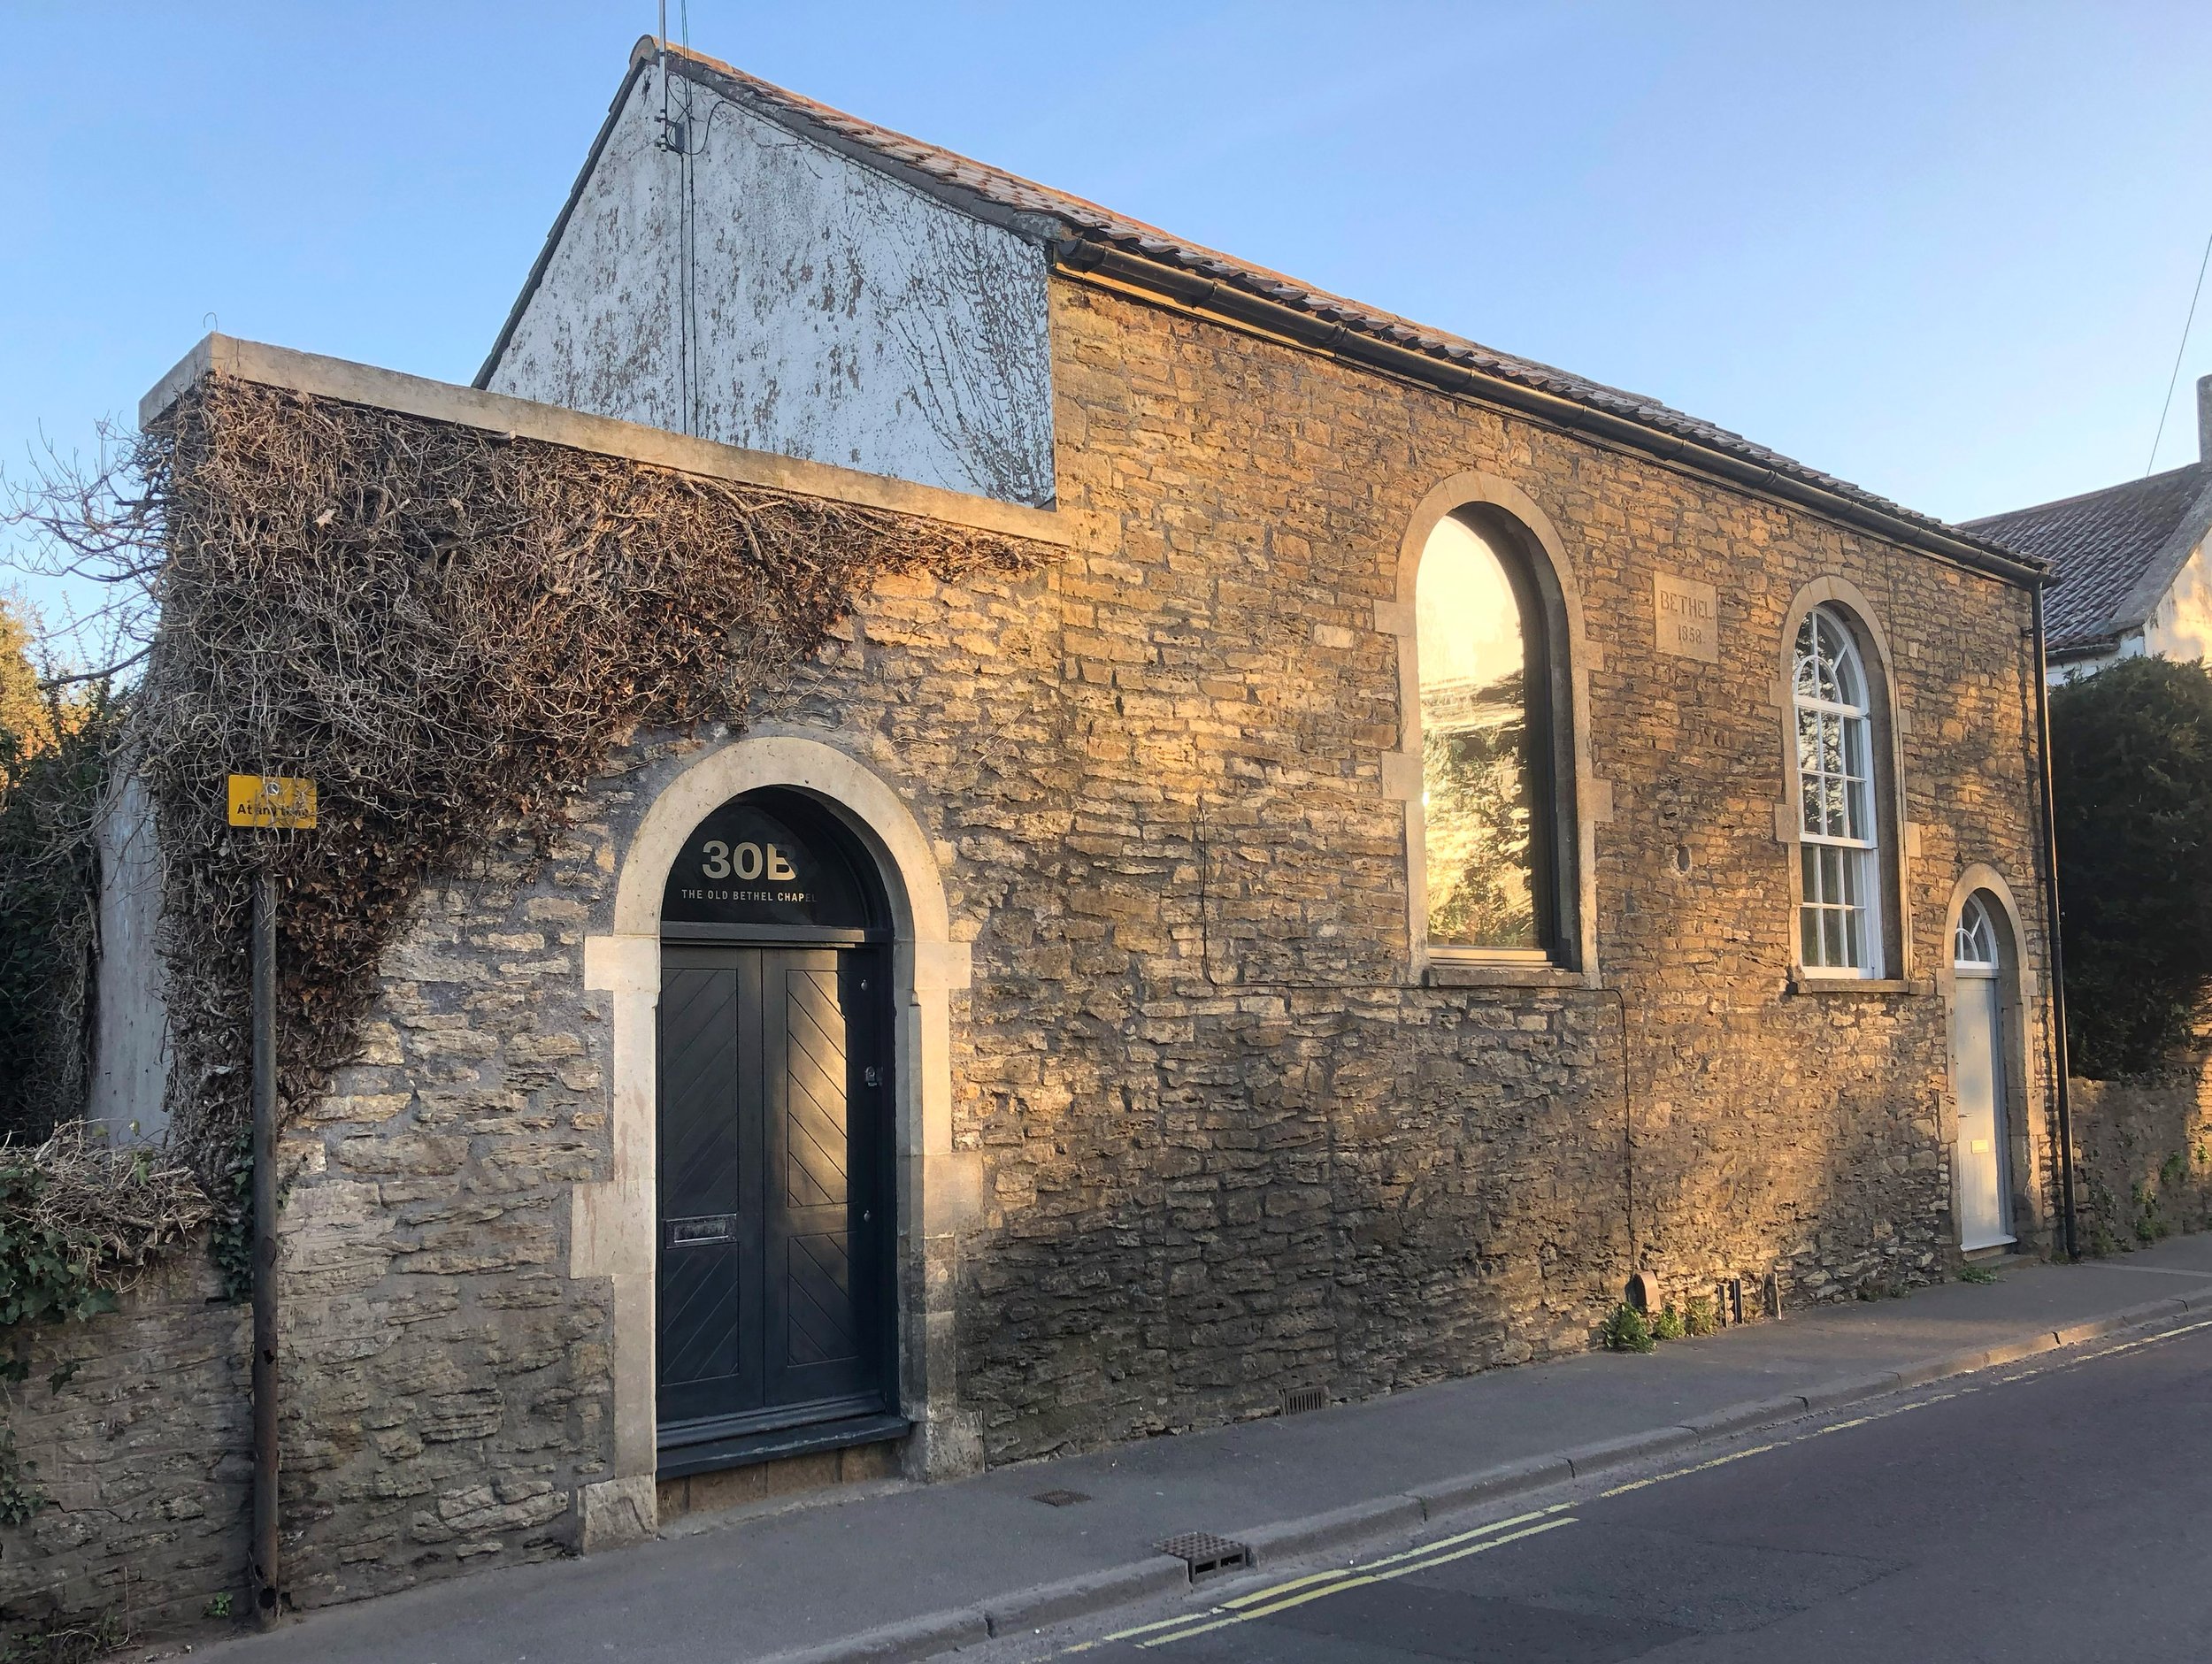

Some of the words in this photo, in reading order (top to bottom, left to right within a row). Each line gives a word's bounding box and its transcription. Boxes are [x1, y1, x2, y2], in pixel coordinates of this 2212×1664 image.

[236, 803, 252, 815] At
[681, 889, 703, 900] THE
[707, 890, 728, 901] OLD
[733, 891, 773, 901] BETHEL
[777, 892, 818, 902] CHAPEL
